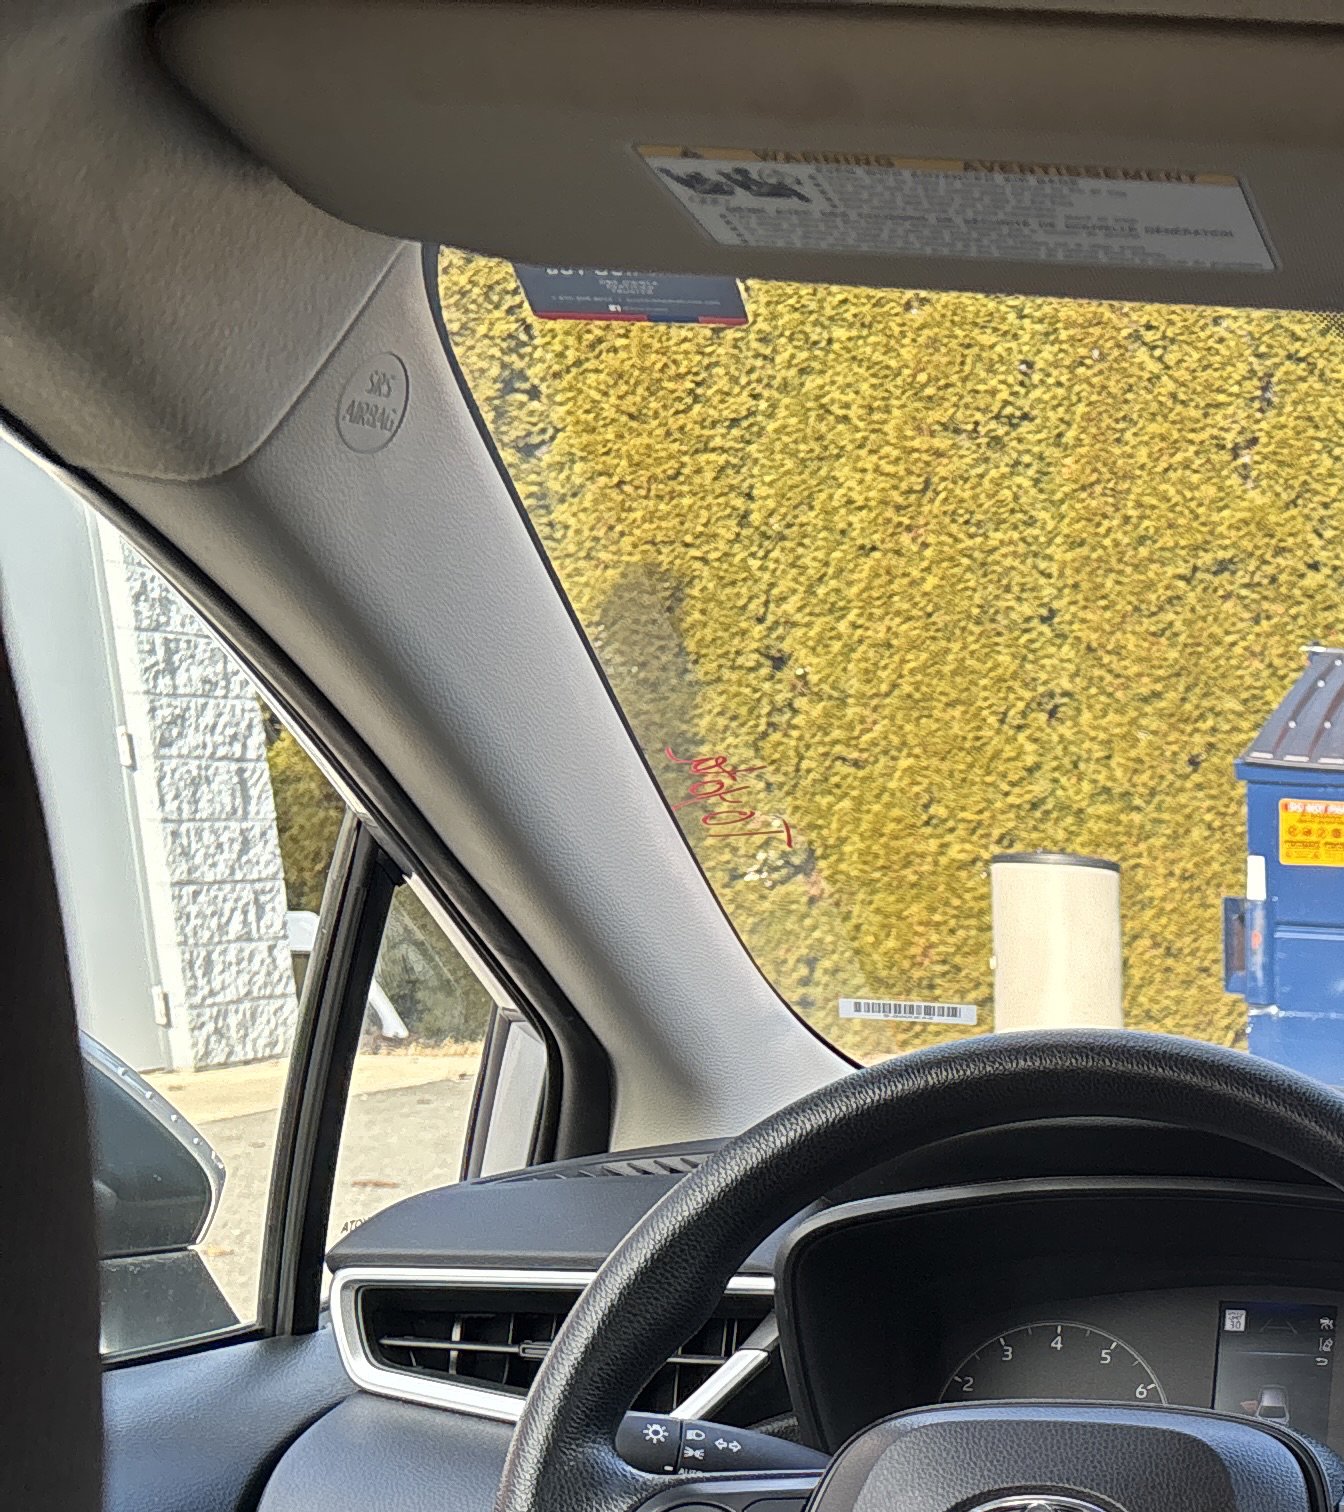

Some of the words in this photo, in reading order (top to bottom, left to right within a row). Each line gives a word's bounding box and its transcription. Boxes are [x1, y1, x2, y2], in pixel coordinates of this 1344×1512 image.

[1230, 1321, 1241, 1330] 30
[1050, 1336, 1063, 1350] 4
[1002, 1346, 1013, 1361] 3
[1100, 1349, 1111, 1364] 5
[962, 1377, 974, 1392] 2
[1135, 1384, 1148, 1398] 6
